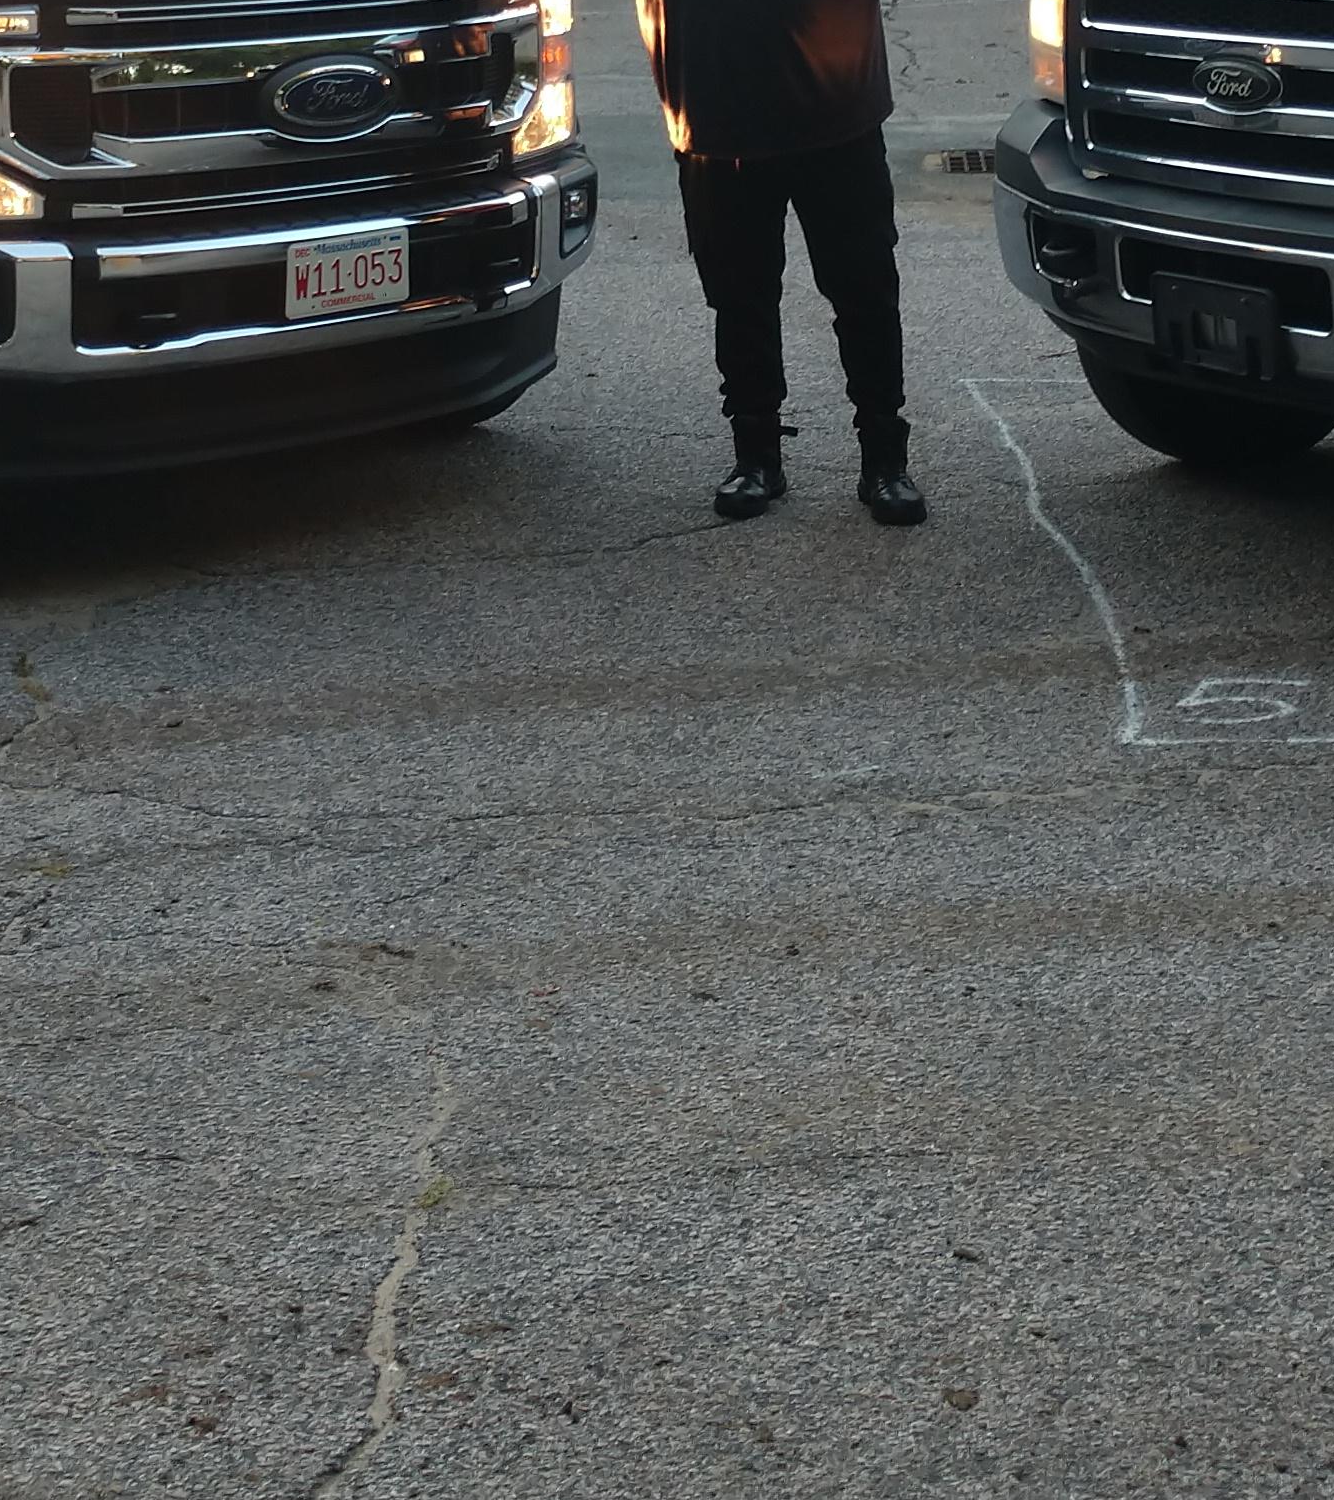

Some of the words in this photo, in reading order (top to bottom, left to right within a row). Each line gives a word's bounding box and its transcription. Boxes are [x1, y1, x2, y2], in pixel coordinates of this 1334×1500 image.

[306, 78, 370, 110] Ford
[1207, 68, 1253, 97] Ford
[295, 248, 311, 259] DEC
